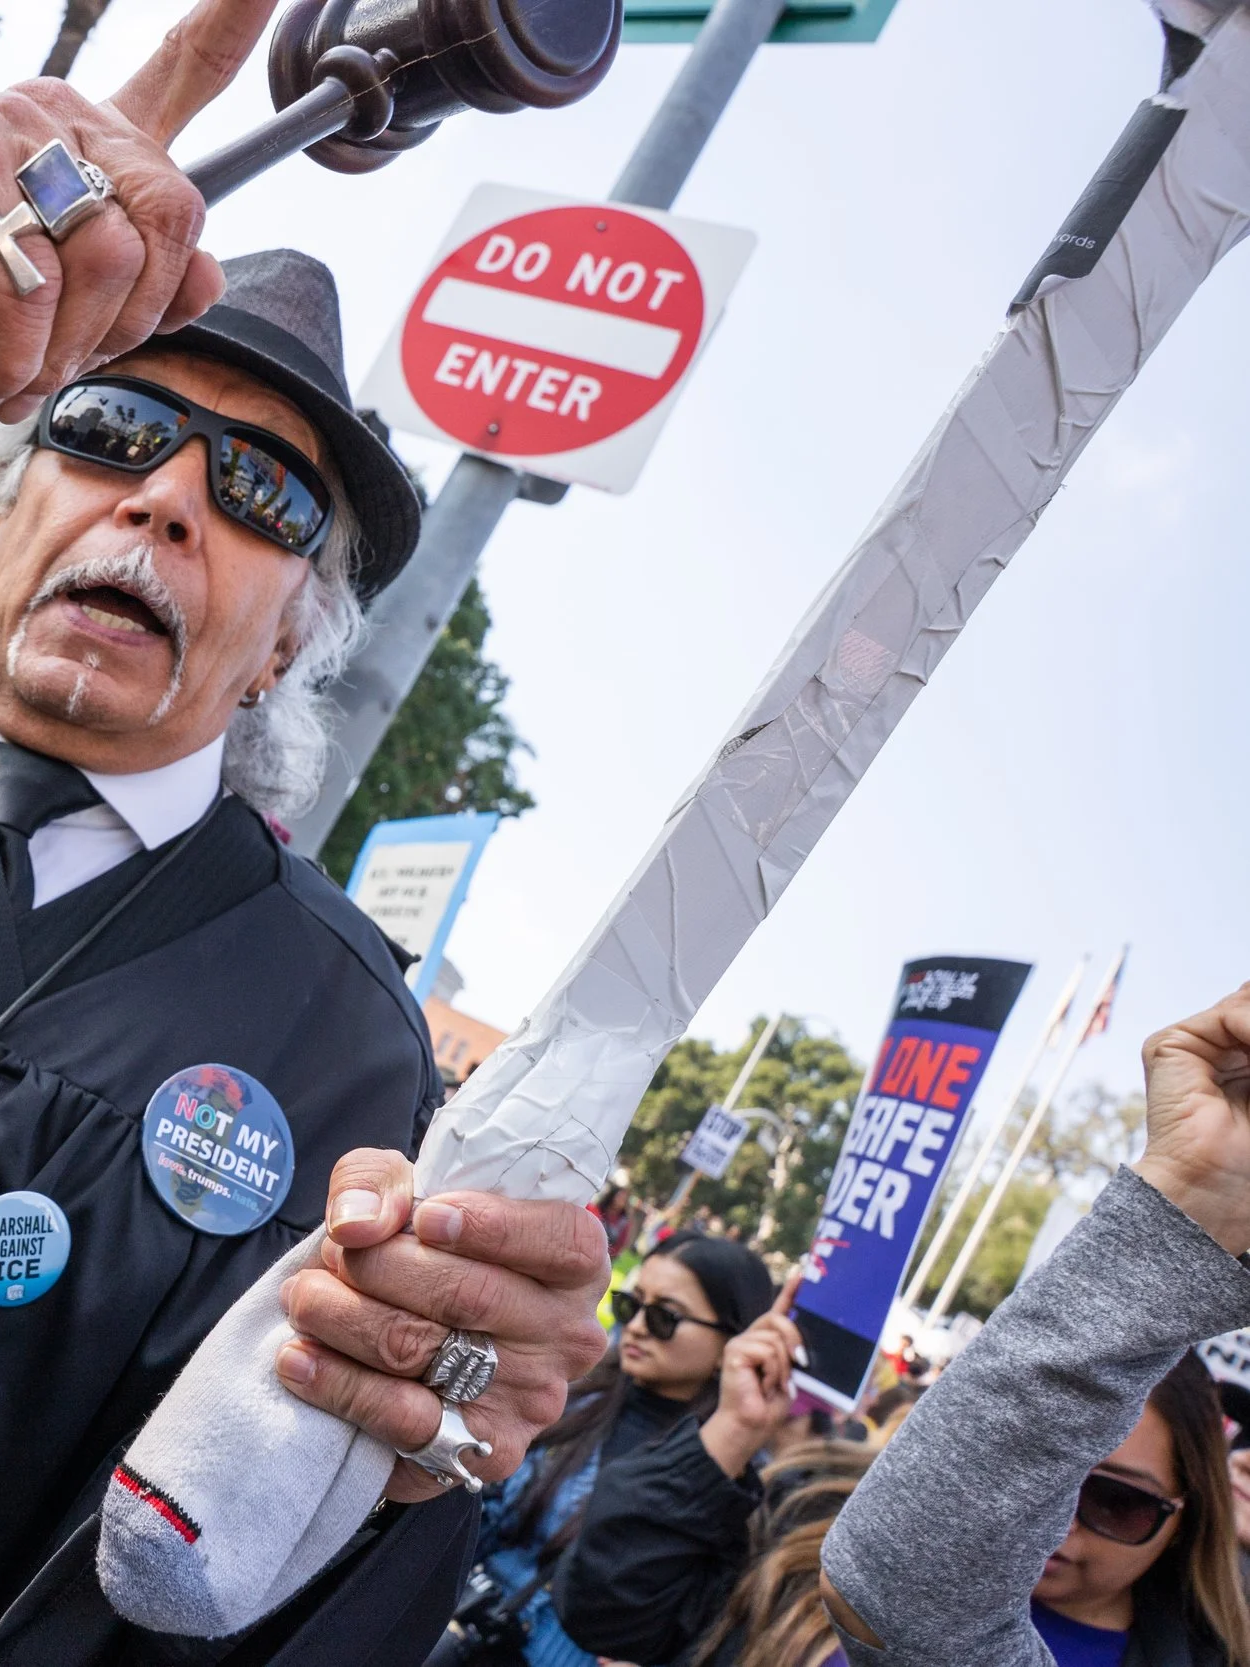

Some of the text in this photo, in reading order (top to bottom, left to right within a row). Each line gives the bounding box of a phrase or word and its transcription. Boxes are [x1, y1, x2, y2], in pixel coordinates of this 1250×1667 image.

[475, 234, 686, 311] DO NOT
[434, 342, 603, 423] ENTER
[155, 1117, 280, 1193] PRESIDENT
[174, 1092, 279, 1160] NOT MY
